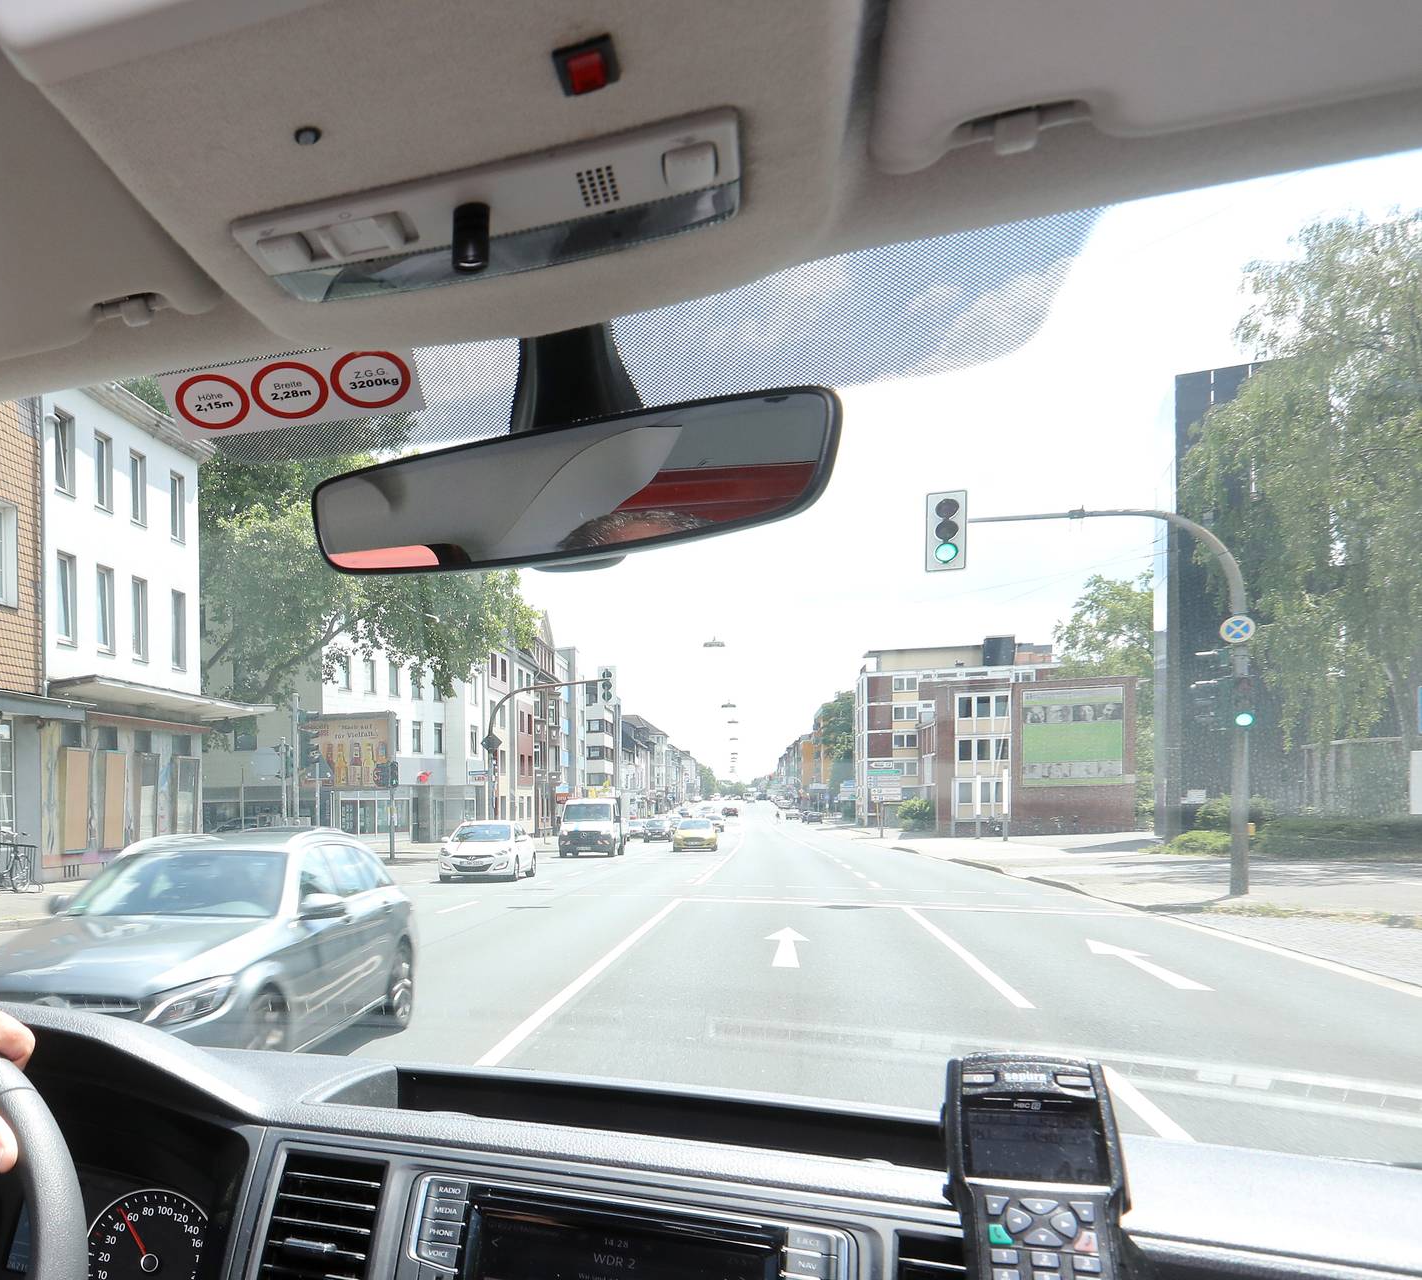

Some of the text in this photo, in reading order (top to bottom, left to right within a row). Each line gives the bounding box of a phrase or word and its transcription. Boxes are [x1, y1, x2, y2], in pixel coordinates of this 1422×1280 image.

[354, 367, 388, 380] Z.G.G.
[273, 380, 303, 391] Breite
[349, 377, 400, 390] 3200kg
[197, 392, 224, 402] Höhe
[271, 389, 312, 401] 2,28m
[194, 401, 234, 412] 2,15m
[438, 1186, 461, 1195] RADIO
[141, 1206, 154, 1217] 80
[157, 1205, 173, 1216] 100
[434, 1206, 458, 1215] MEDIA
[127, 1212, 139, 1222] 60
[173, 1213, 189, 1223] 120
[113, 1222, 126, 1232] 40
[183, 1224, 200, 1235] 140
[429, 1228, 454, 1238] PHONE
[105, 1234, 117, 1245] 30
[98, 1252, 111, 1262] 20
[428, 1249, 449, 1258] VOICE
[593, 1252, 636, 1270] WDR 2
[798, 1260, 817, 1270] NAV
[97, 1270, 108, 1280] 10
